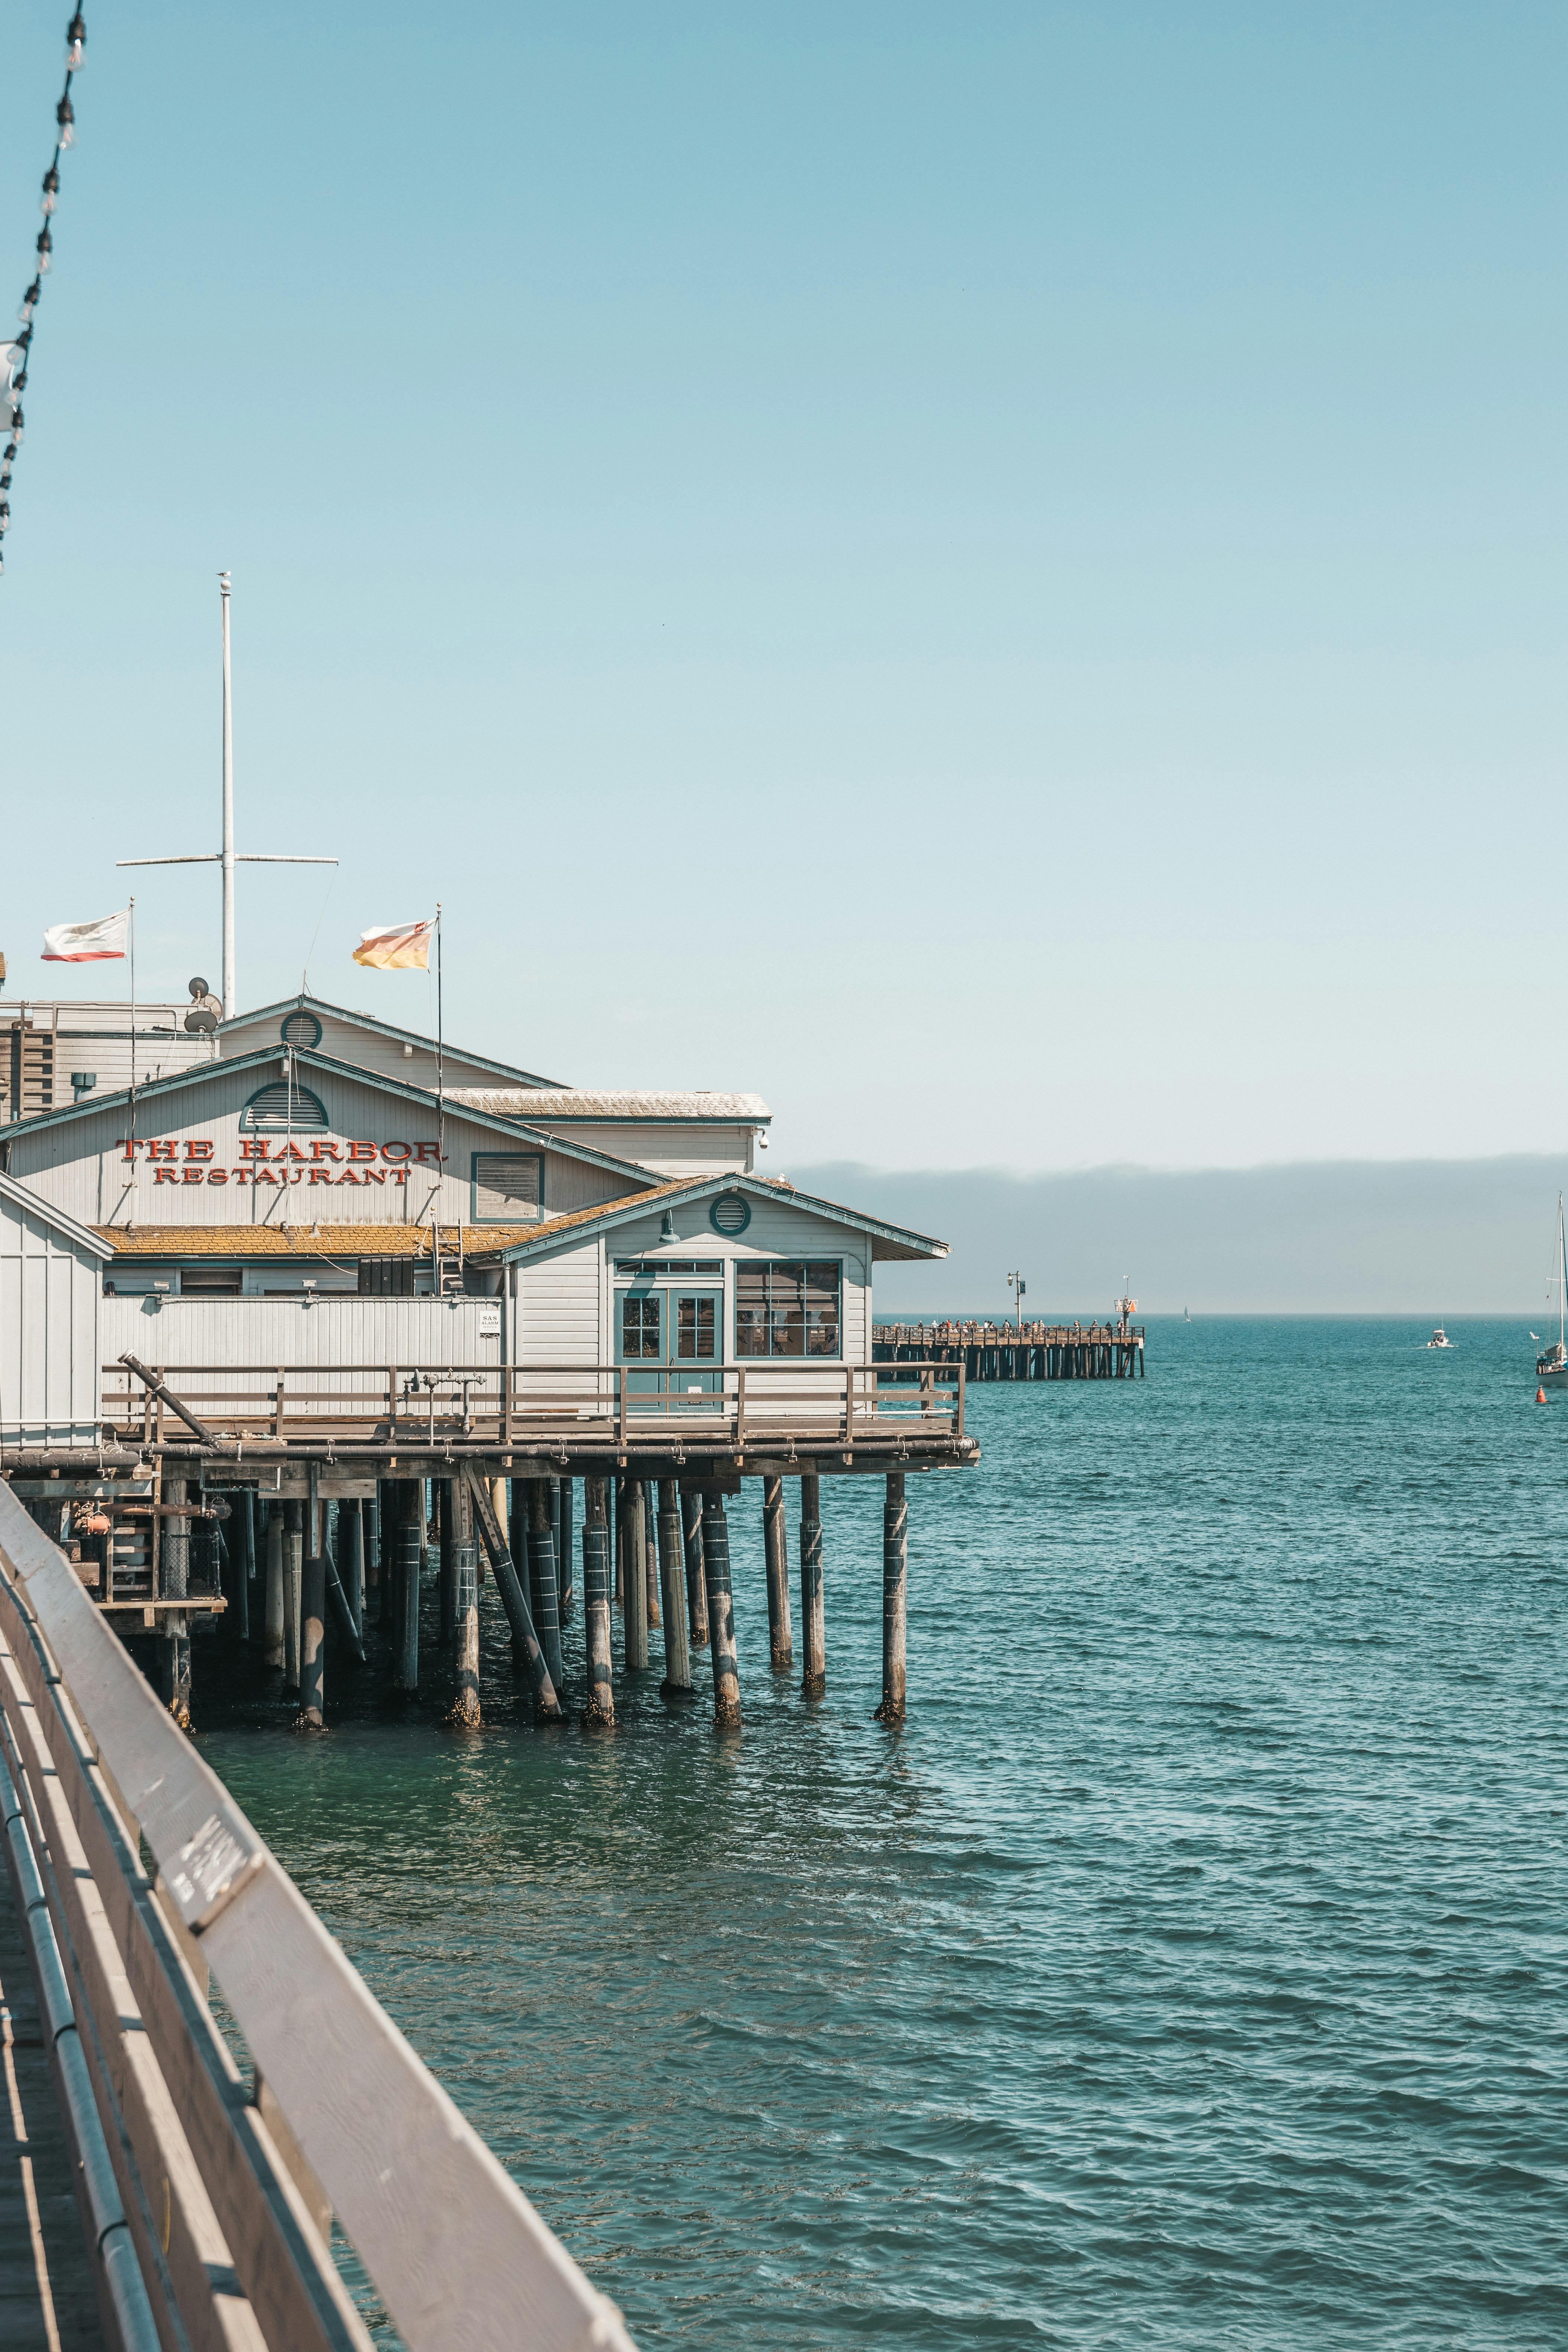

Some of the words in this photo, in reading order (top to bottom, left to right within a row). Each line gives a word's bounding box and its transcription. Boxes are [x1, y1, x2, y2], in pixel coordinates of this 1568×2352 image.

[116, 1139, 215, 1159] THE
[238, 1139, 449, 1162] HARBOR
[154, 1167, 412, 1183] RESTAURANT
